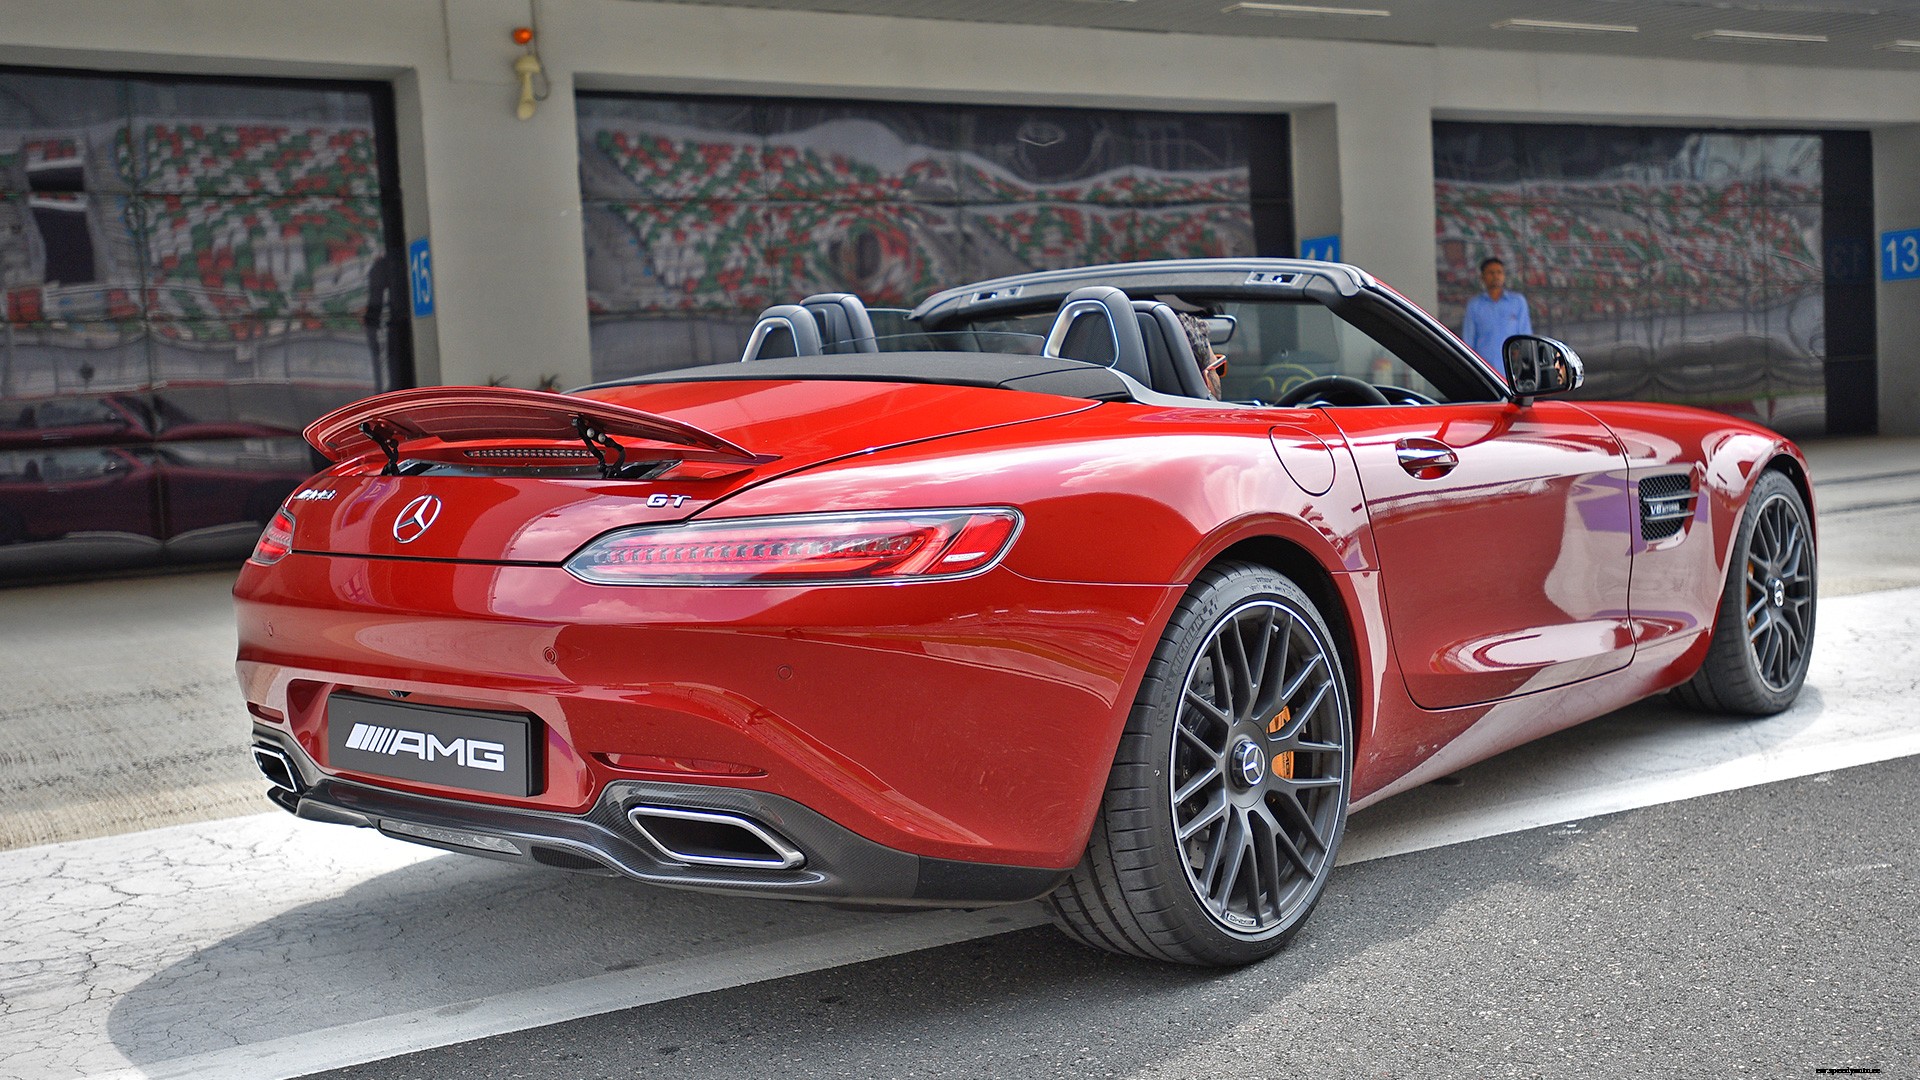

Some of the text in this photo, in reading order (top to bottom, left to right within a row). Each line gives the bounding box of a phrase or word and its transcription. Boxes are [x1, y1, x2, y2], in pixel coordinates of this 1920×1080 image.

[1885, 235, 1919, 273] 13
[413, 250, 431, 304] 15
[646, 493, 692, 508] GT
[387, 729, 505, 772] AMG
